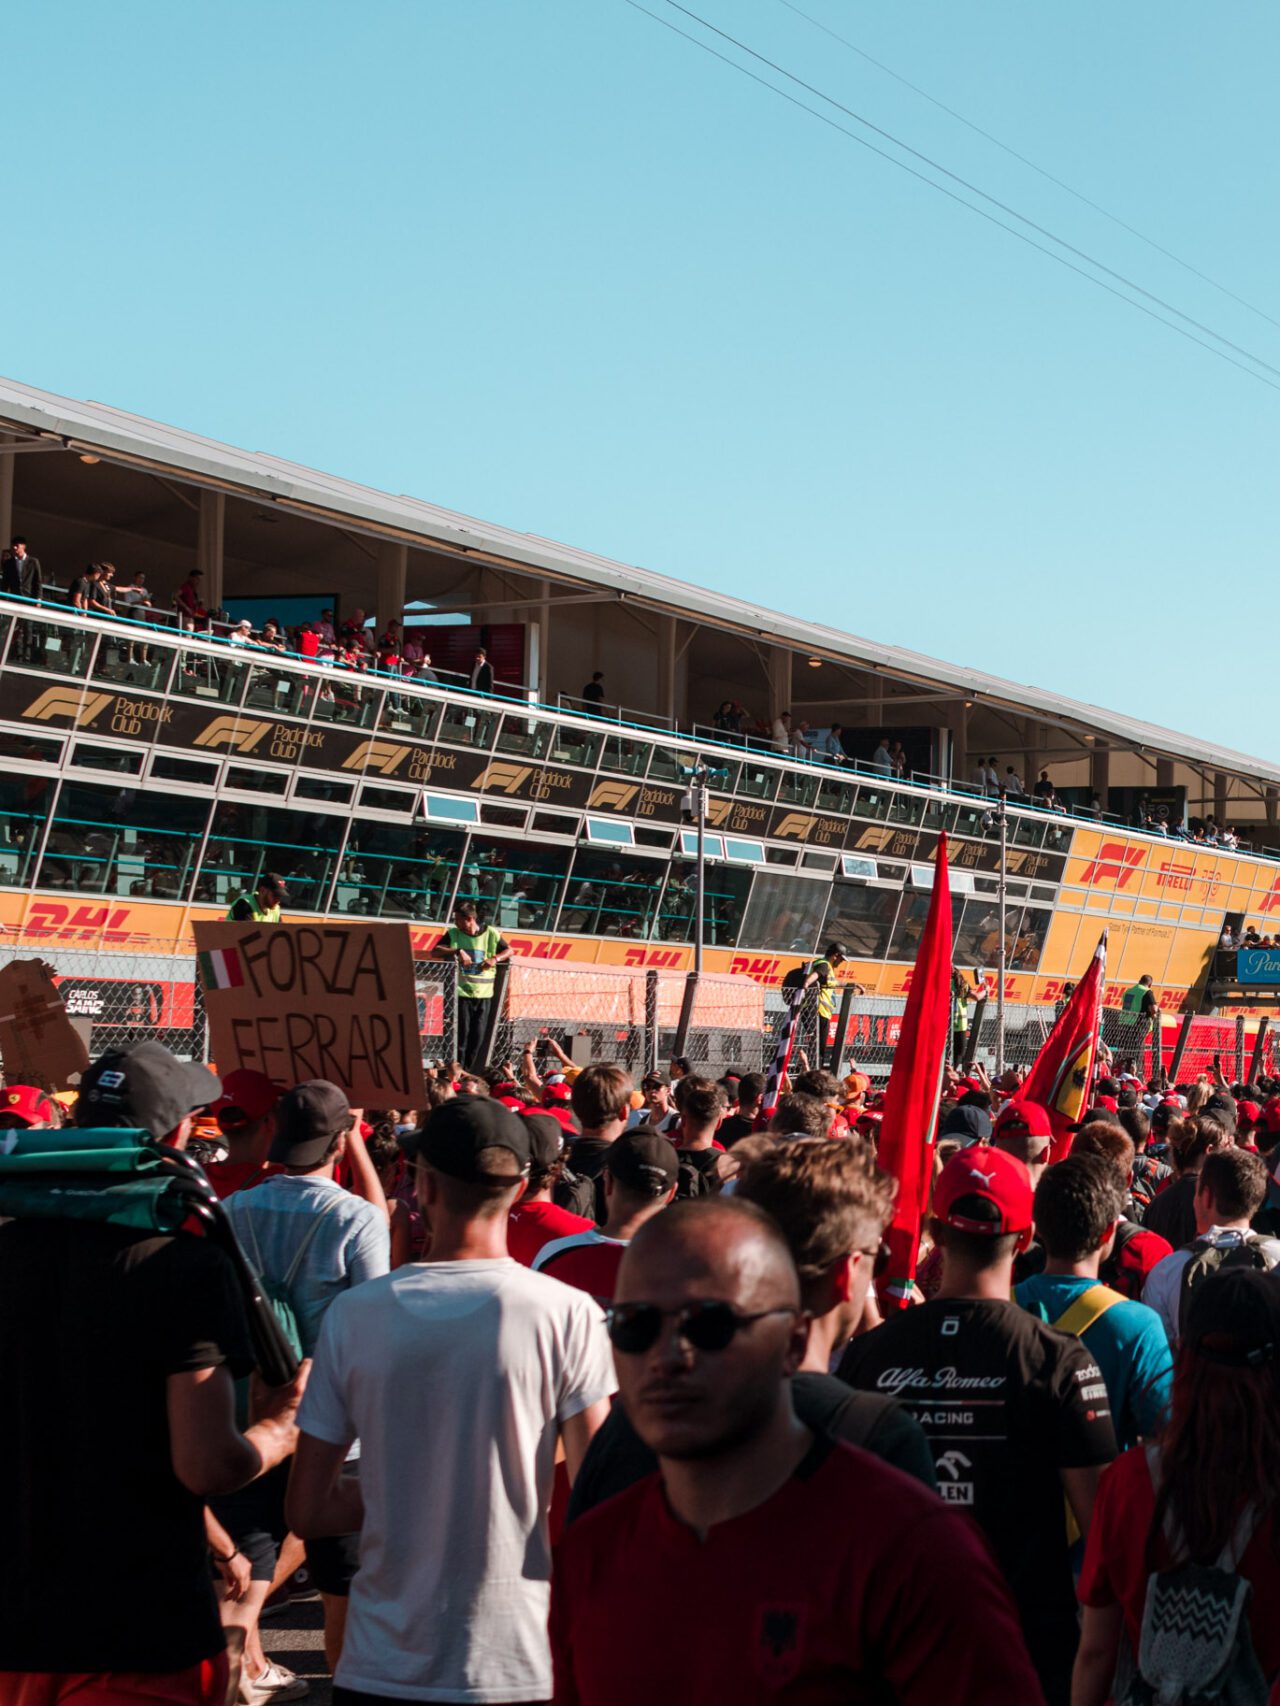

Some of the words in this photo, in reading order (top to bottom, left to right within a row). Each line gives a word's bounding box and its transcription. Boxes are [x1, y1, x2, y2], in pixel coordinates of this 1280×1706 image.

[115, 697, 174, 723] Paddock
[111, 714, 141, 735] Club
[273, 724, 326, 748] Paddock
[270, 741, 297, 759] Club
[411, 748, 457, 770] Paddock
[408, 763, 432, 780] Club
[534, 769, 573, 788] Paddock
[529, 784, 550, 799] Club
[640, 788, 676, 806] Paddock
[637, 800, 656, 815] Club
[1156, 861, 1197, 891] PIRELLI
[27, 902, 132, 943] DHL
[238, 927, 387, 1001] FORZA
[625, 948, 683, 968] DHL
[730, 957, 782, 985] DHL
[68, 989, 99, 1000] CARLOS
[65, 1000, 104, 1015] SAINZ
[230, 1012, 410, 1096] FERRARI
[876, 1367, 931, 1396] Alfa
[931, 1366, 1007, 1389] Romeo
